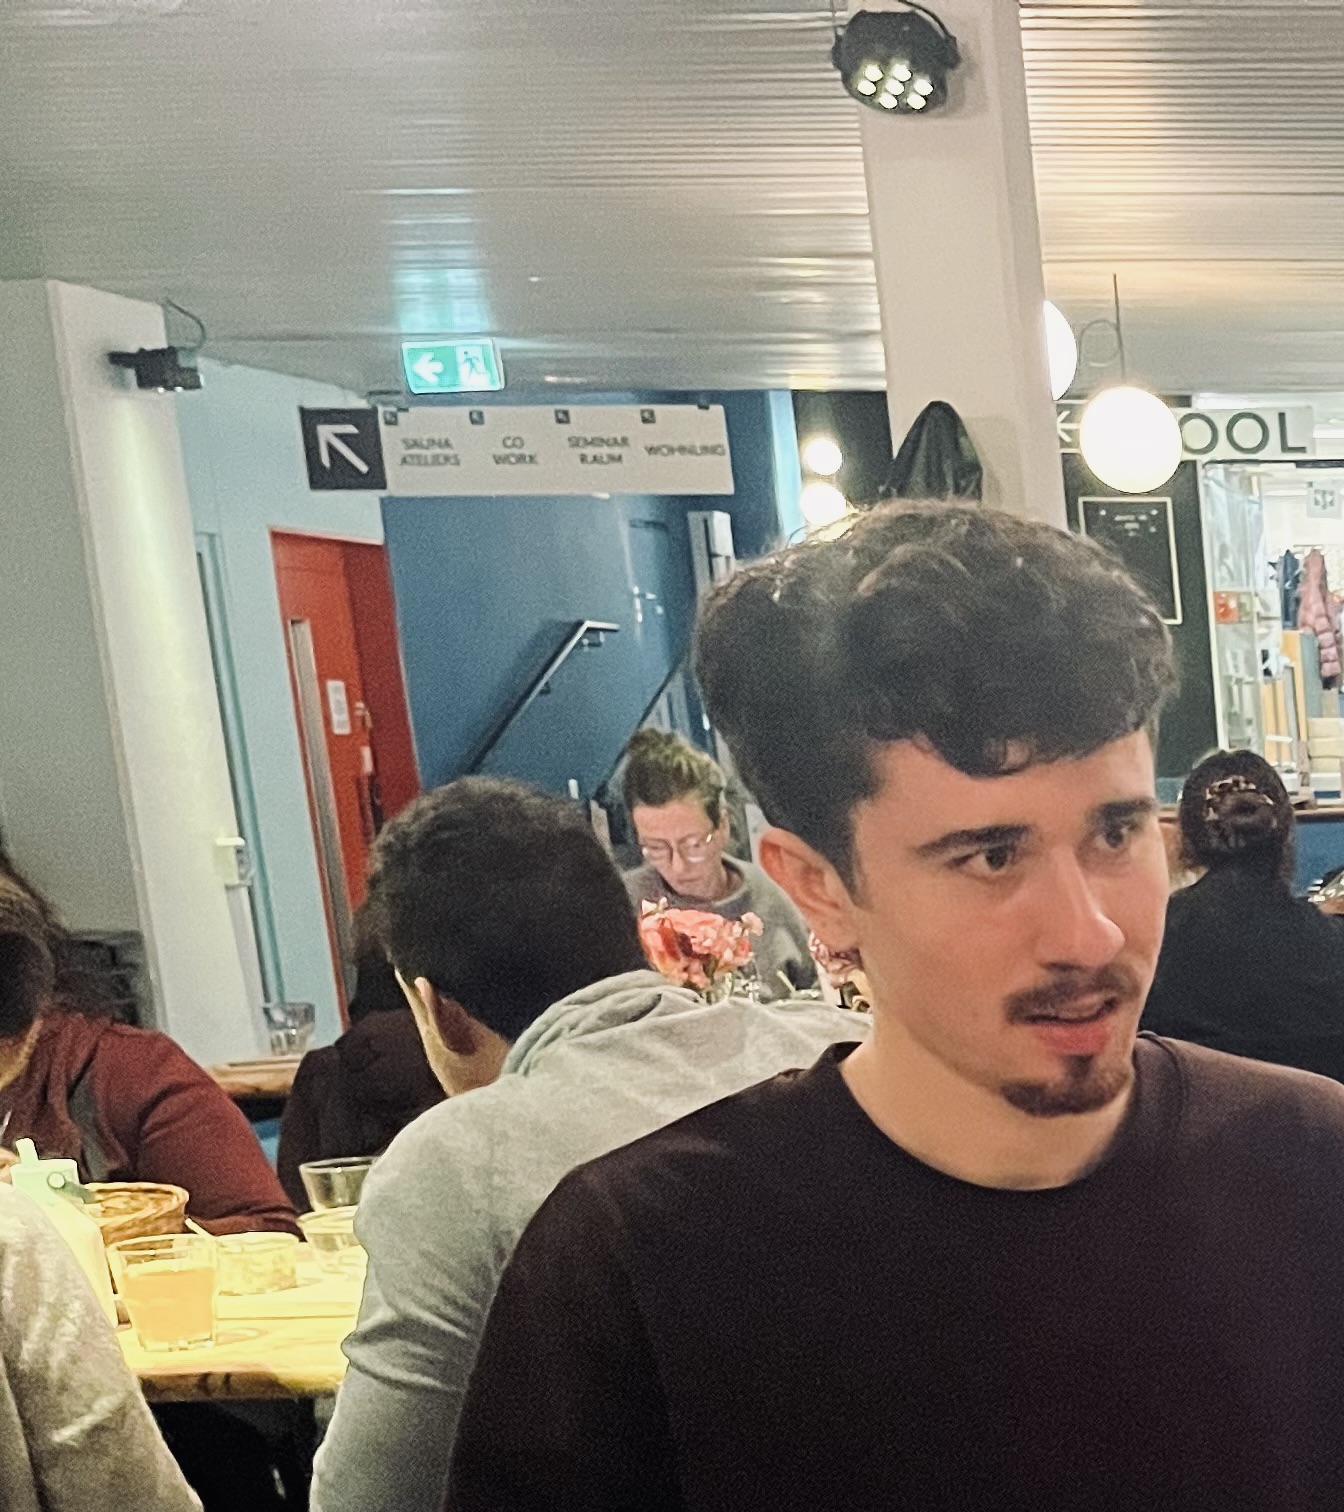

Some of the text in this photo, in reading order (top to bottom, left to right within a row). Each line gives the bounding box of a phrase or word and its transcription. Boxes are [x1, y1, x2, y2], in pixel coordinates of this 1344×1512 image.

[1180, 411, 1307, 455] OOL
[401, 437, 453, 450] SAUNA
[502, 436, 525, 449] CO
[568, 436, 631, 448] SEMINAR
[644, 443, 727, 456] WOHNUNG
[400, 453, 461, 466] ATELIERS
[493, 453, 539, 465] WORK
[580, 453, 623, 465] RAUM
